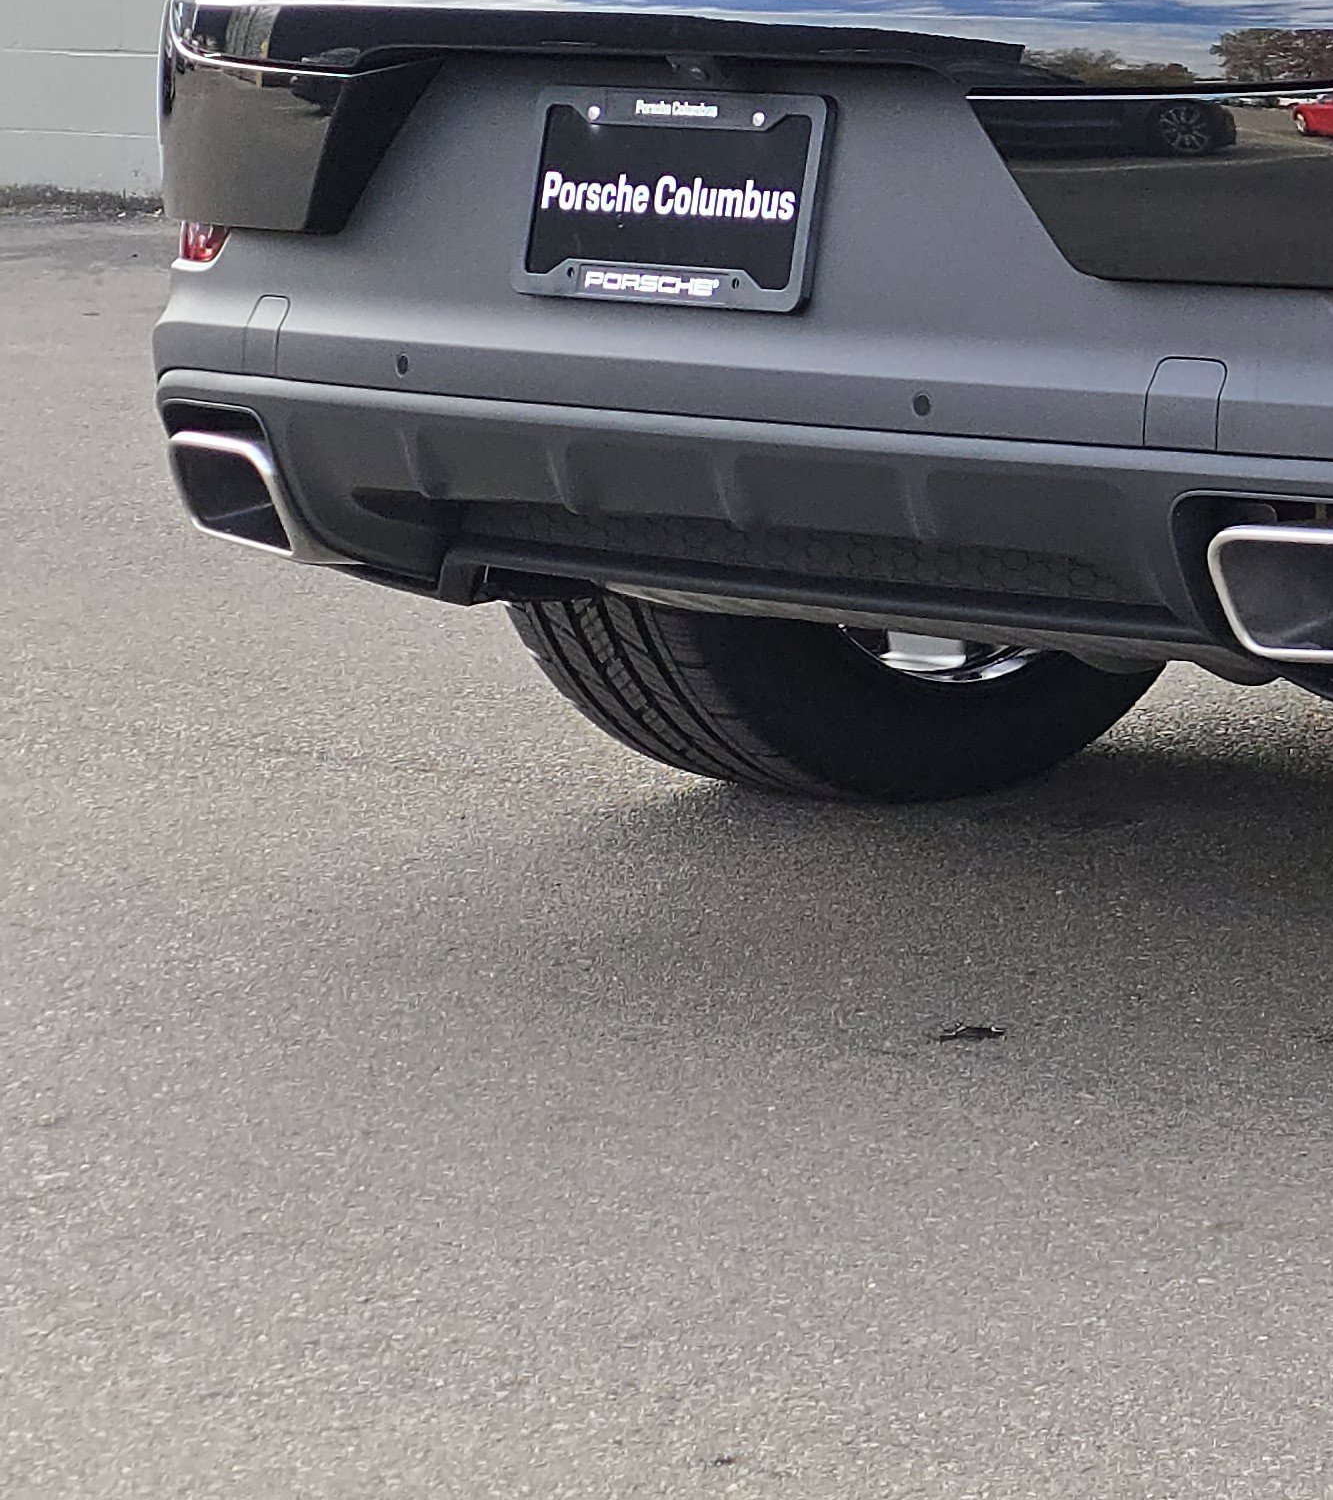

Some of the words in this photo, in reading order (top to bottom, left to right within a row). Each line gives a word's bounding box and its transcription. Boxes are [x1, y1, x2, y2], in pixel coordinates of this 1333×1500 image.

[541, 170, 650, 214] Porsche
[653, 174, 797, 221] Columbus
[584, 270, 714, 297] PORSCHE
